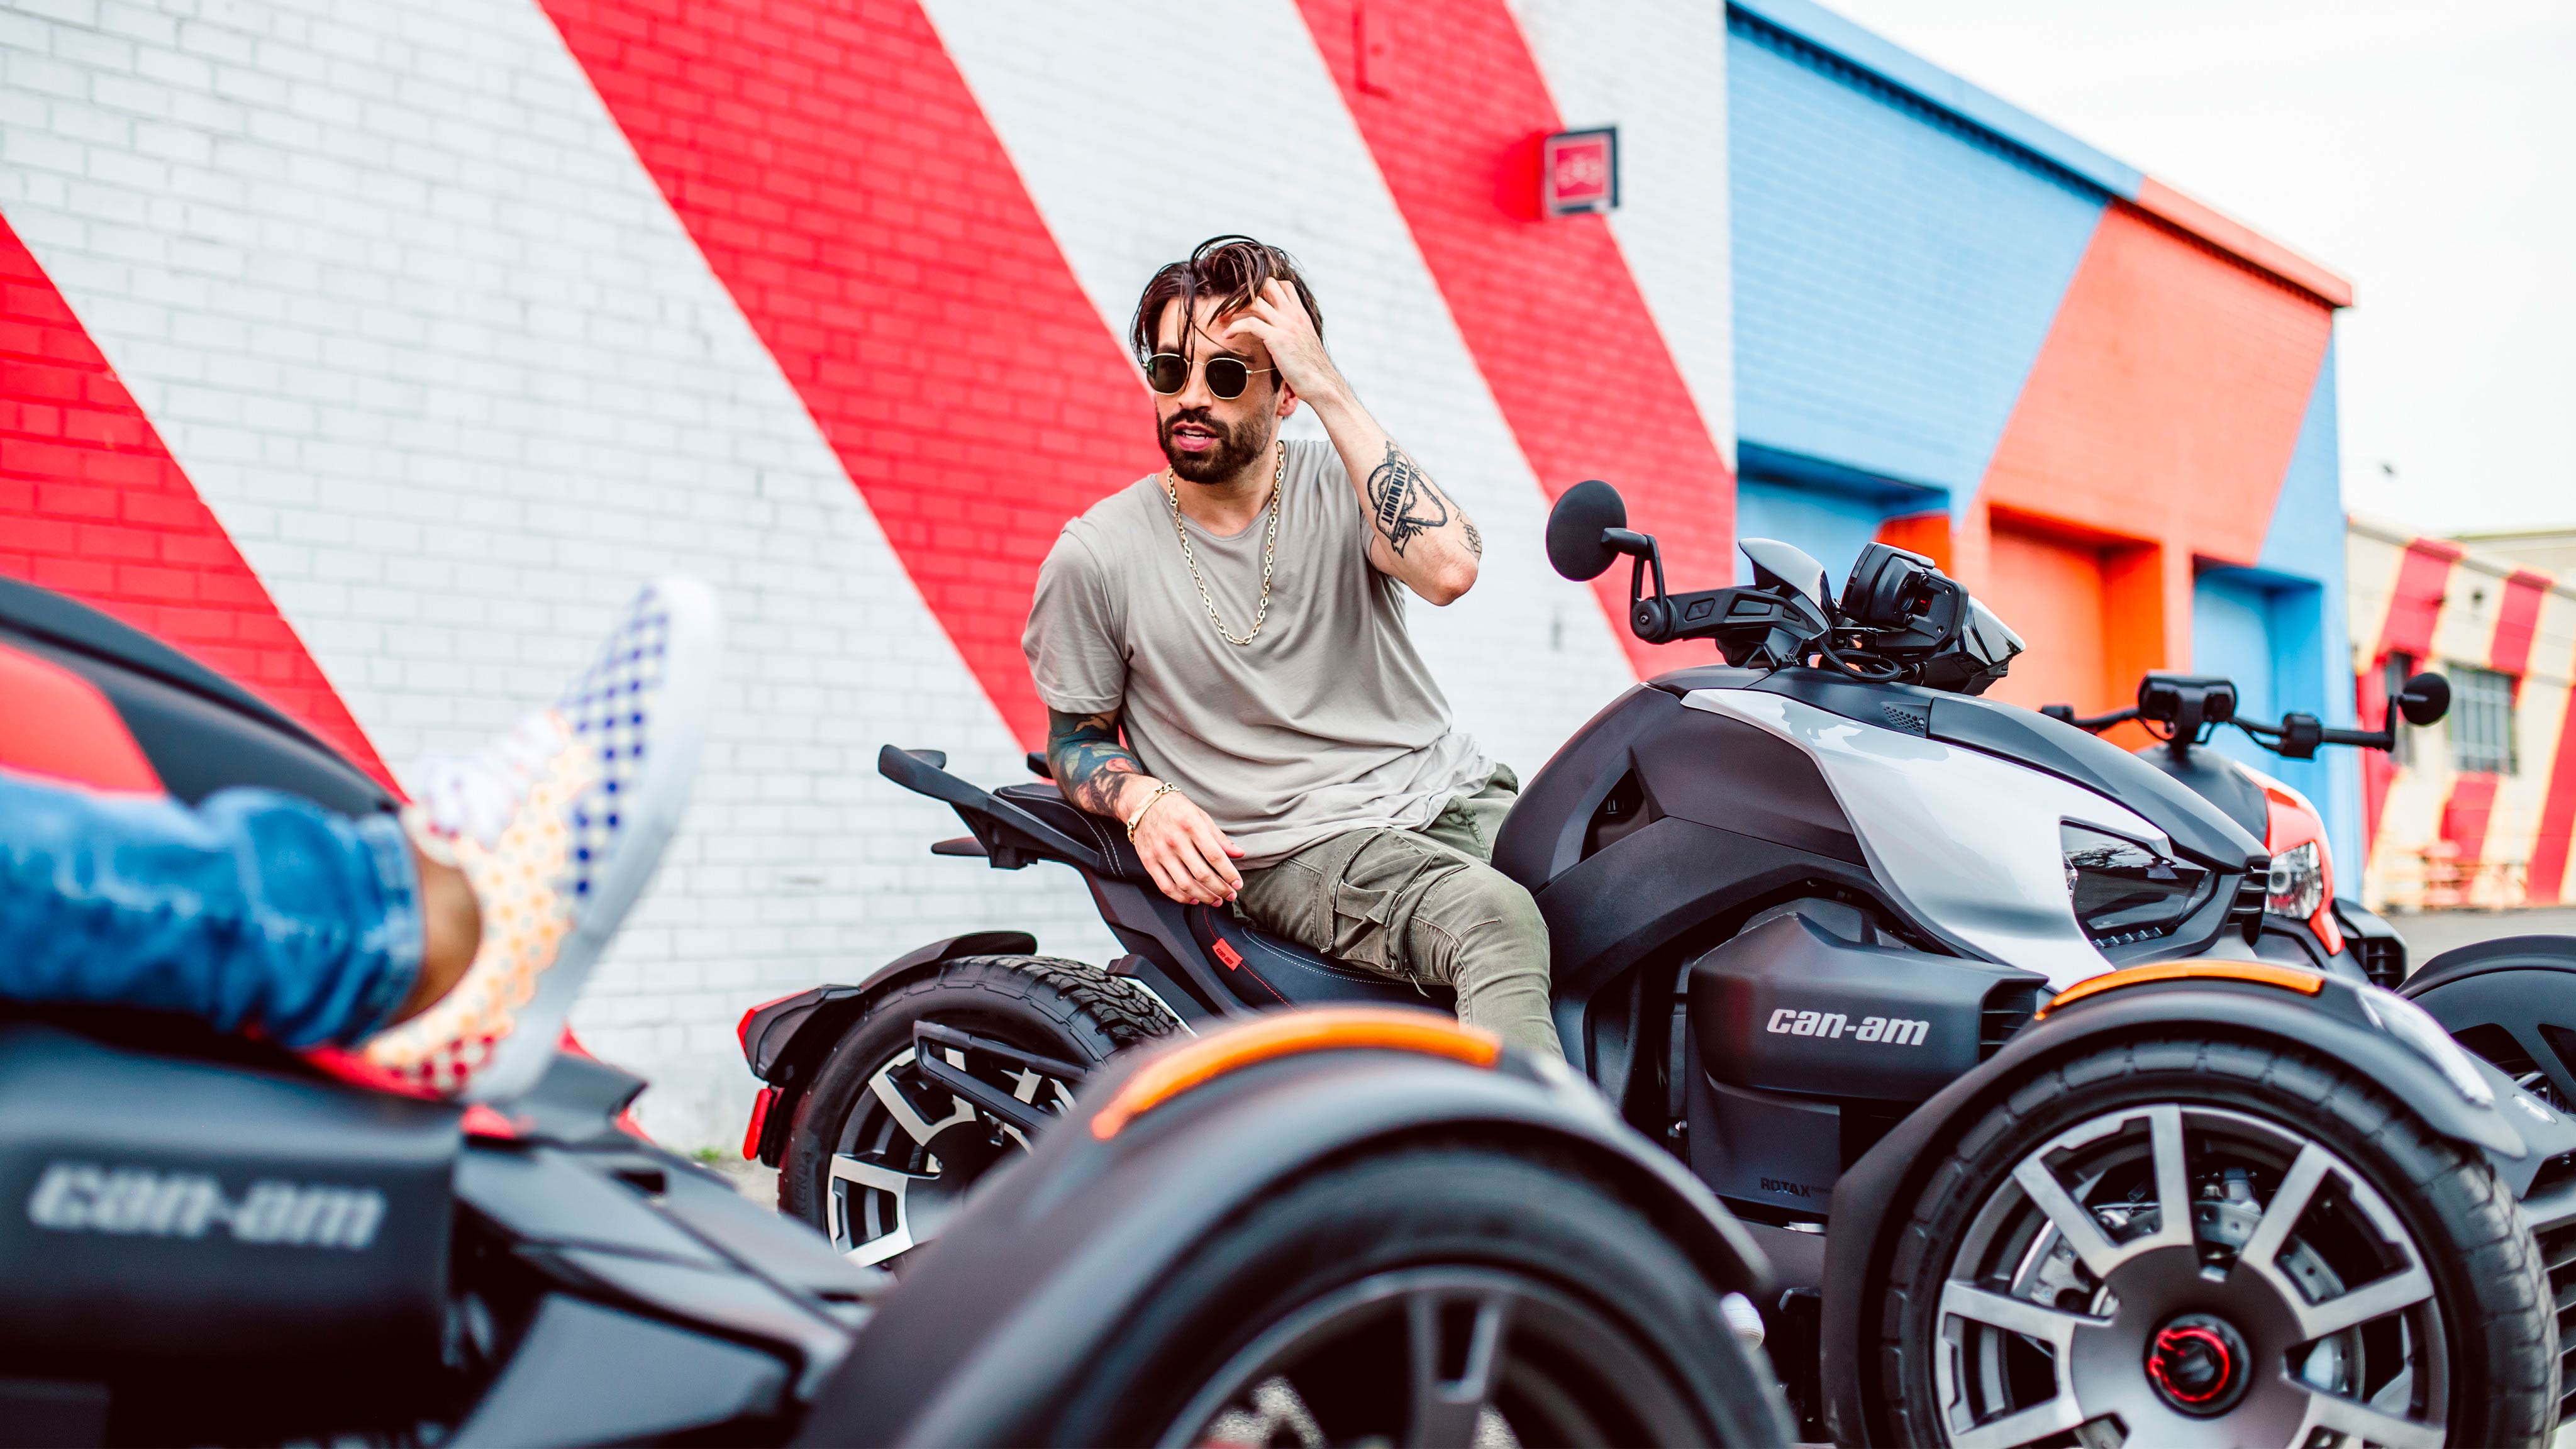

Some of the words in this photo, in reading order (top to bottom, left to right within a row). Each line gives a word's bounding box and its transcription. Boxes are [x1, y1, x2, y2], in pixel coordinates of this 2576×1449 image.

[1381, 461, 1407, 526] FAIRMOUNT
[1216, 948, 1234, 965] can-am
[1767, 1008, 1930, 1046] can-am
[28, 1163, 387, 1250] can-am
[1760, 1177, 1811, 1198] ROTAX
